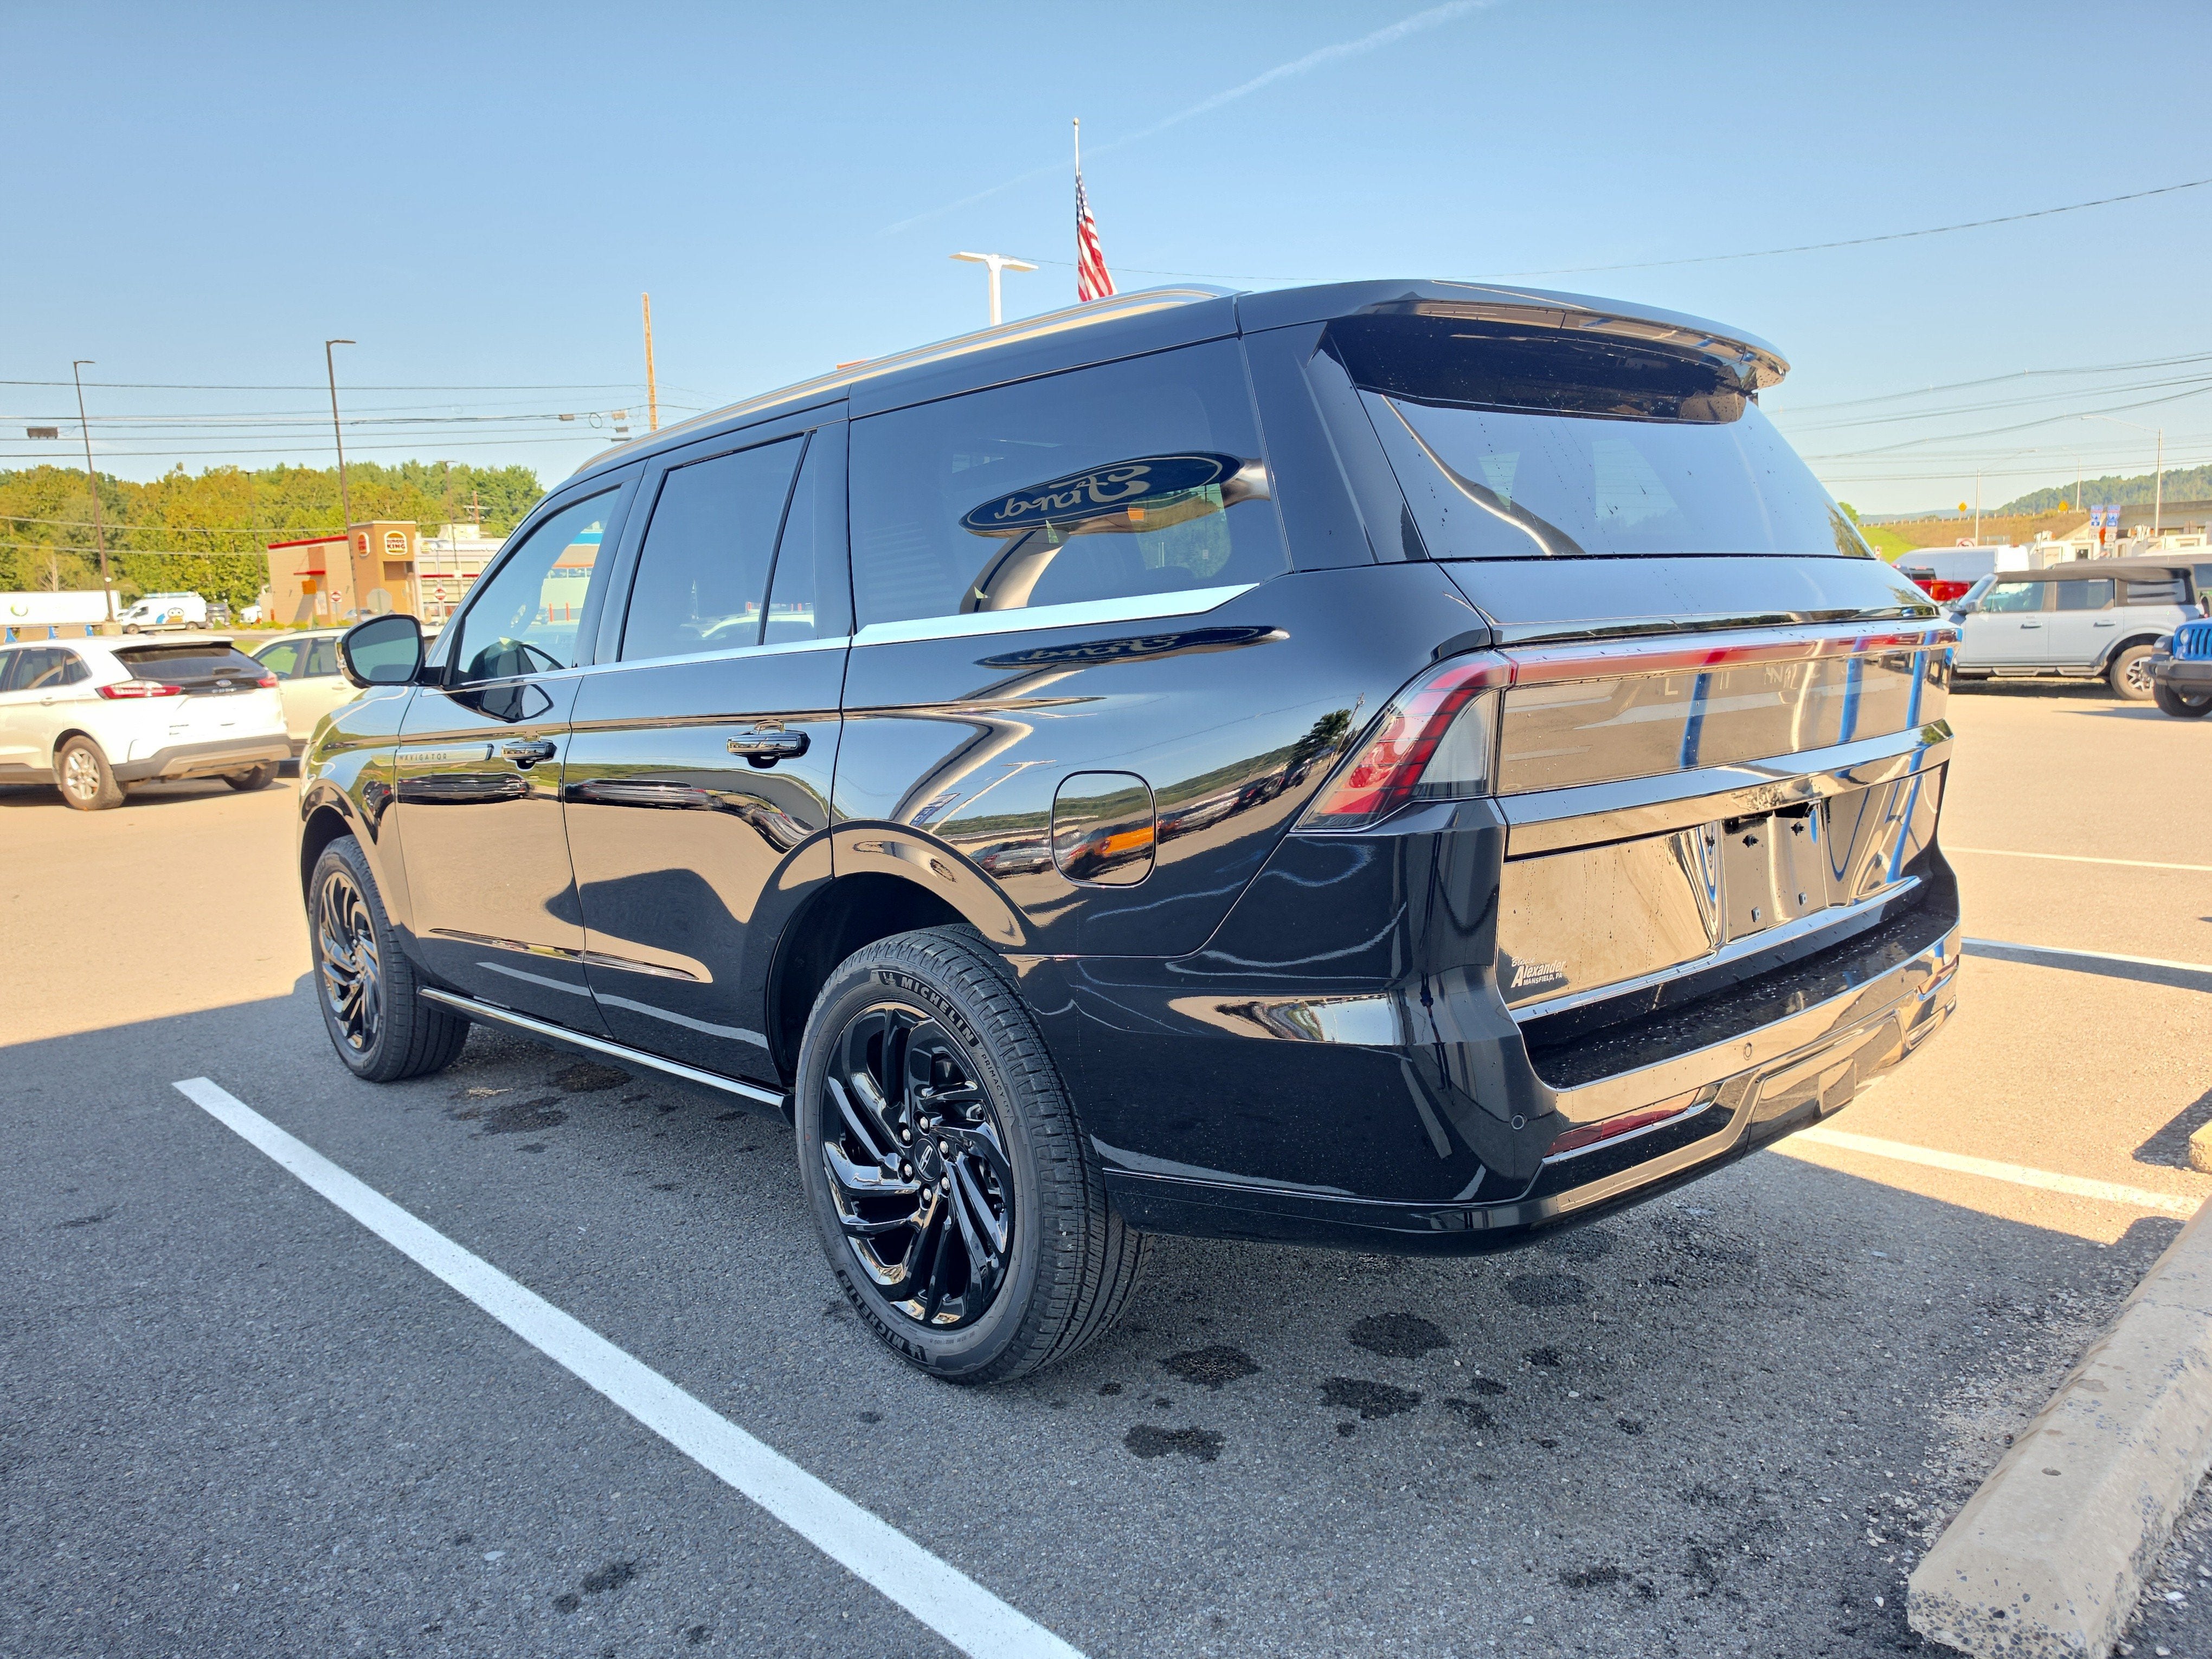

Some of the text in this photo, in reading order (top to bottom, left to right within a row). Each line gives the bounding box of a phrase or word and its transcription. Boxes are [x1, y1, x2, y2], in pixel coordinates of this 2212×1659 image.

[400, 753, 447, 761] NAVIGATOR
[1510, 960, 1567, 988] Alexander
[1523, 974, 1555, 986] MANSFIELD,
[901, 976, 974, 1043] MICHELIN
[981, 1054, 1005, 1097] PRIMACY
[840, 1275, 904, 1350] MICHELIN
